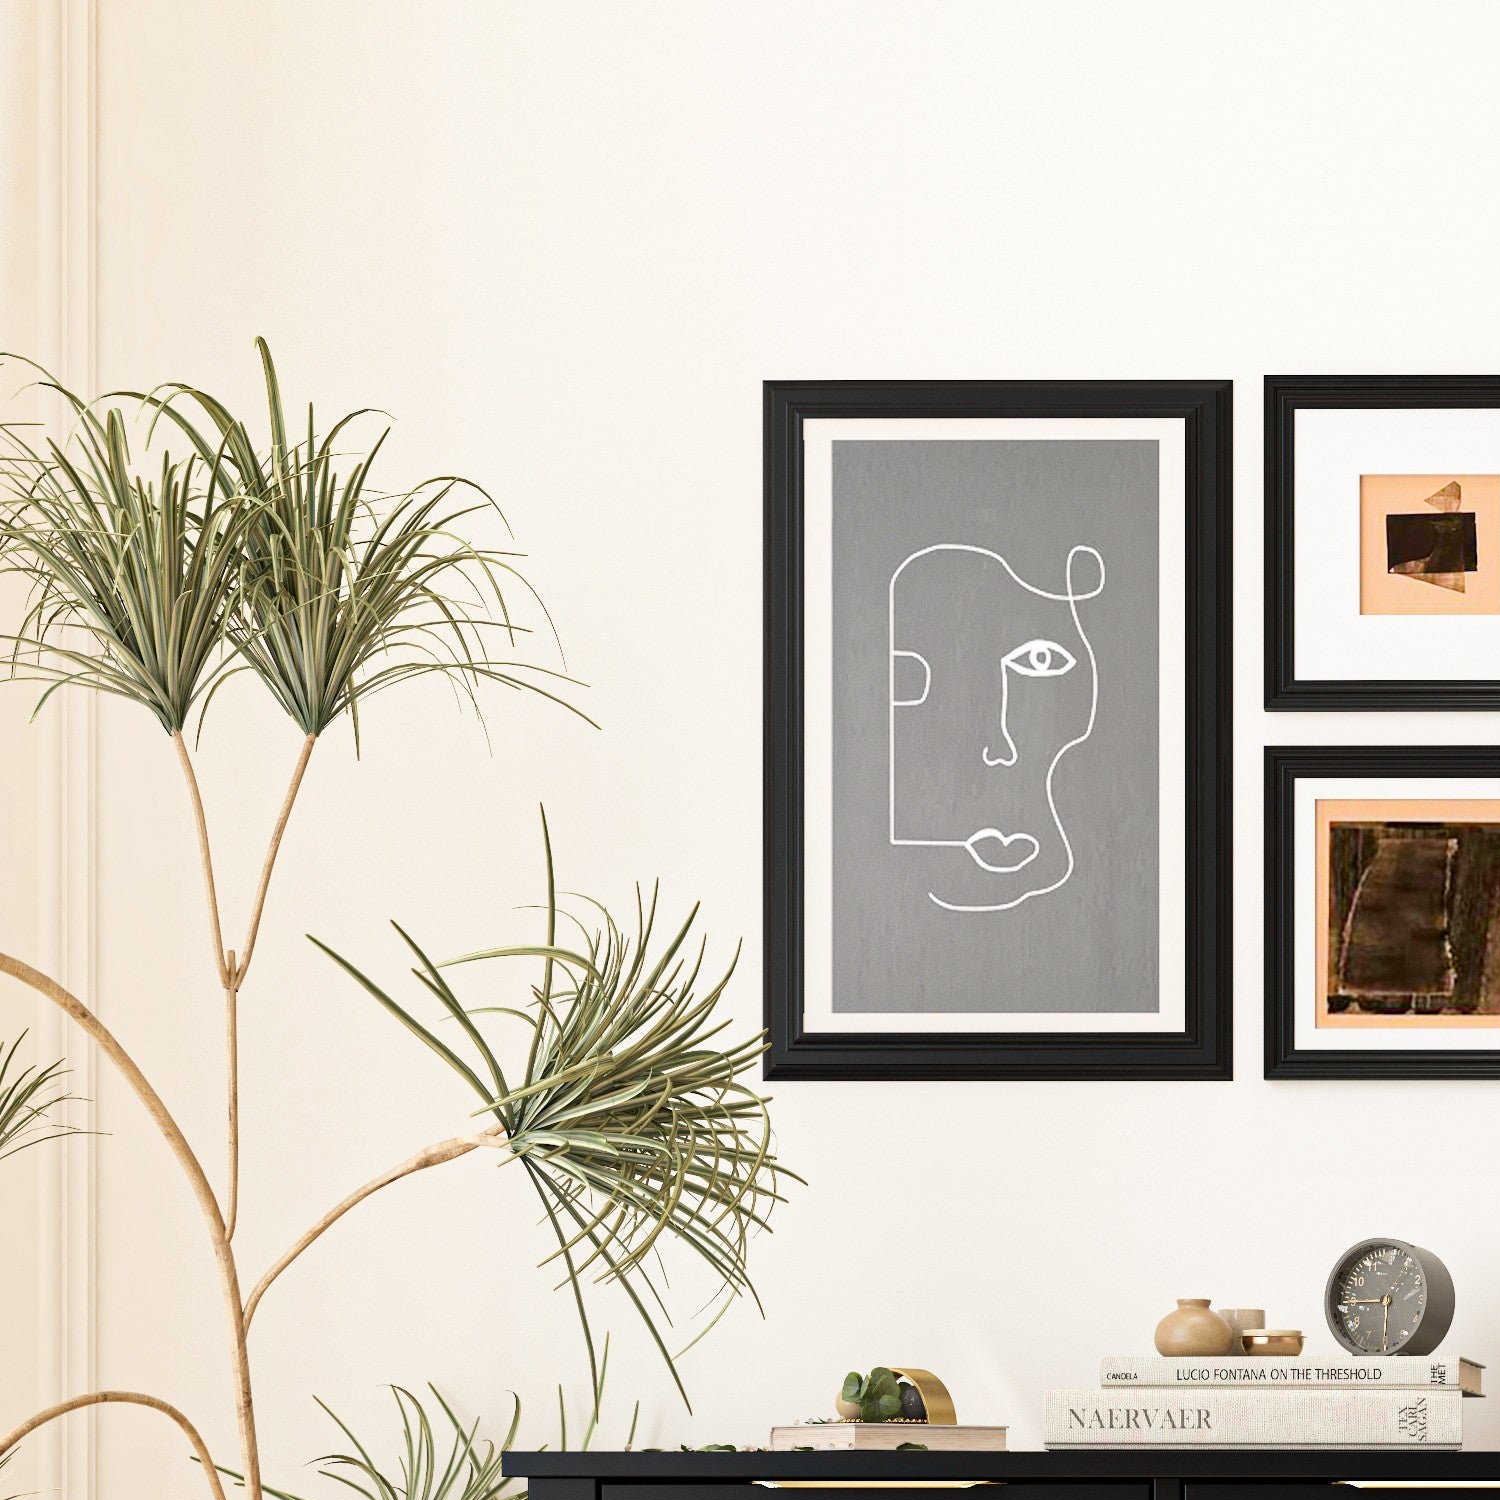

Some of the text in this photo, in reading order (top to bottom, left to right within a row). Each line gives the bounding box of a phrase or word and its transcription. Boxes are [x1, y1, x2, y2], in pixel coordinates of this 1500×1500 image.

[1354, 1276, 1364, 1286] 10
[1415, 1275, 1421, 1284] 2
[1106, 1372, 1138, 1380] CANDELA
[1176, 1368, 1382, 1381] LUCIO FONTANA ON THE THRESHOLD
[1430, 1364, 1438, 1383] THE
[1438, 1363, 1446, 1385] MET
[1068, 1408, 1212, 1430] NAERVAER
[1408, 1404, 1418, 1437] CARL
[1417, 1397, 1427, 1442] SAGAN
